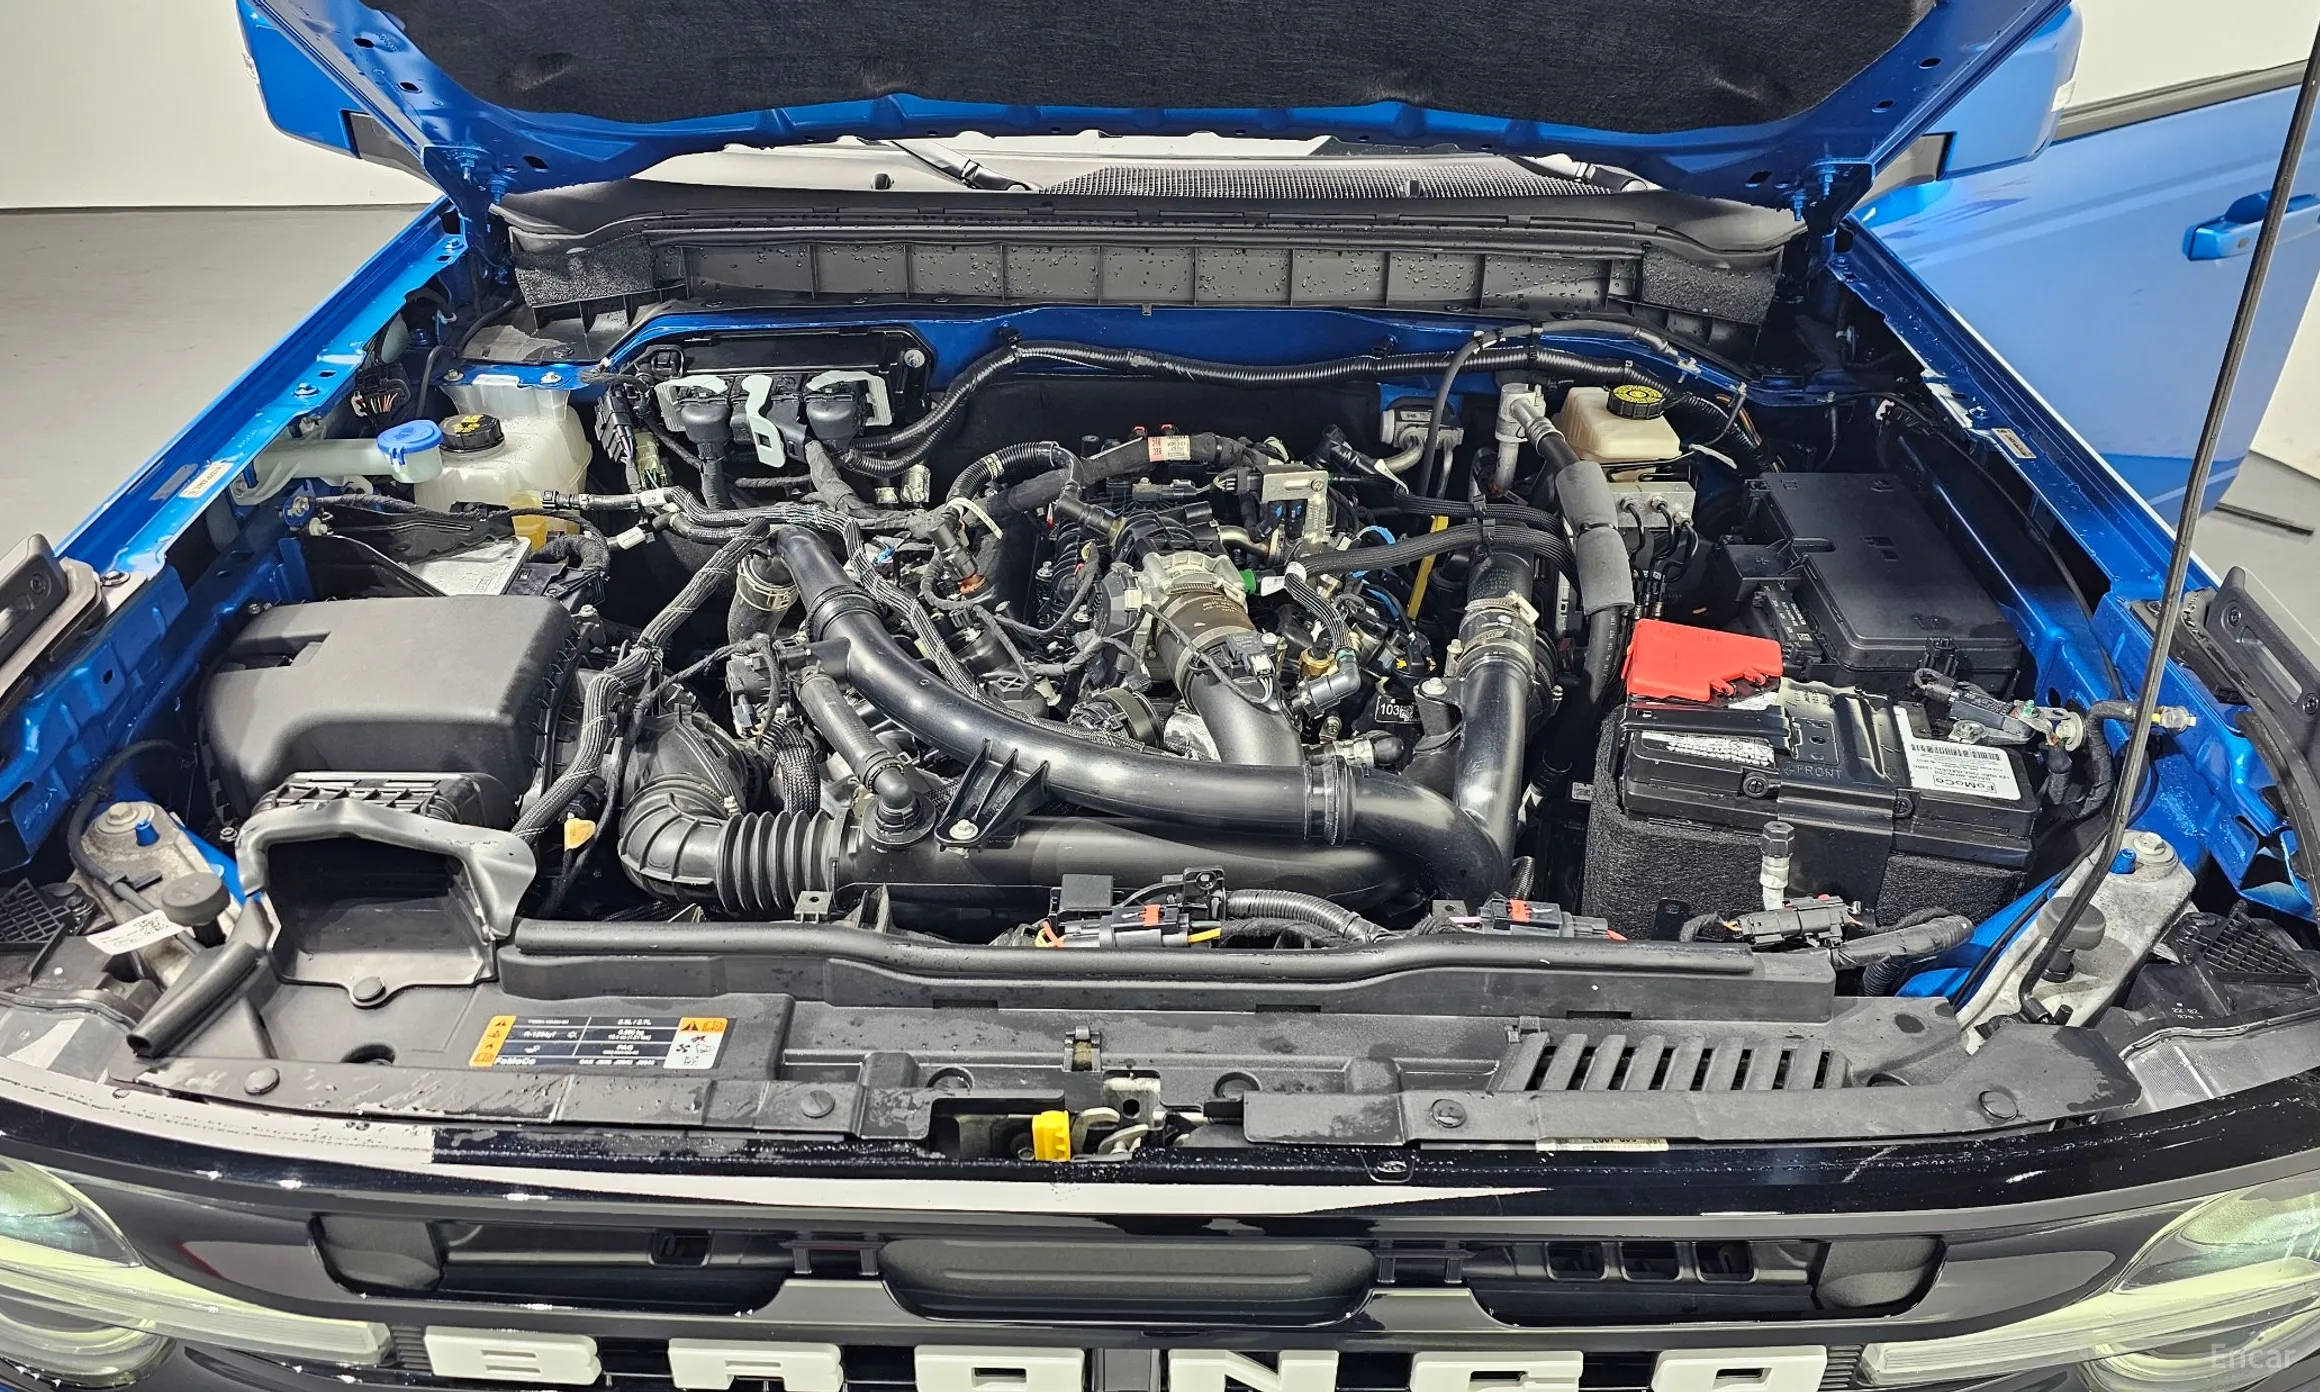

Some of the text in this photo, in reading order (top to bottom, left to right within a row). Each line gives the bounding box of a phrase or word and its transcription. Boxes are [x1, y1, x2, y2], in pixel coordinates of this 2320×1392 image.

[1380, 702, 1400, 716] 103
[1797, 764, 1842, 779] FRONT
[1935, 777, 1995, 791] FoMoCo
